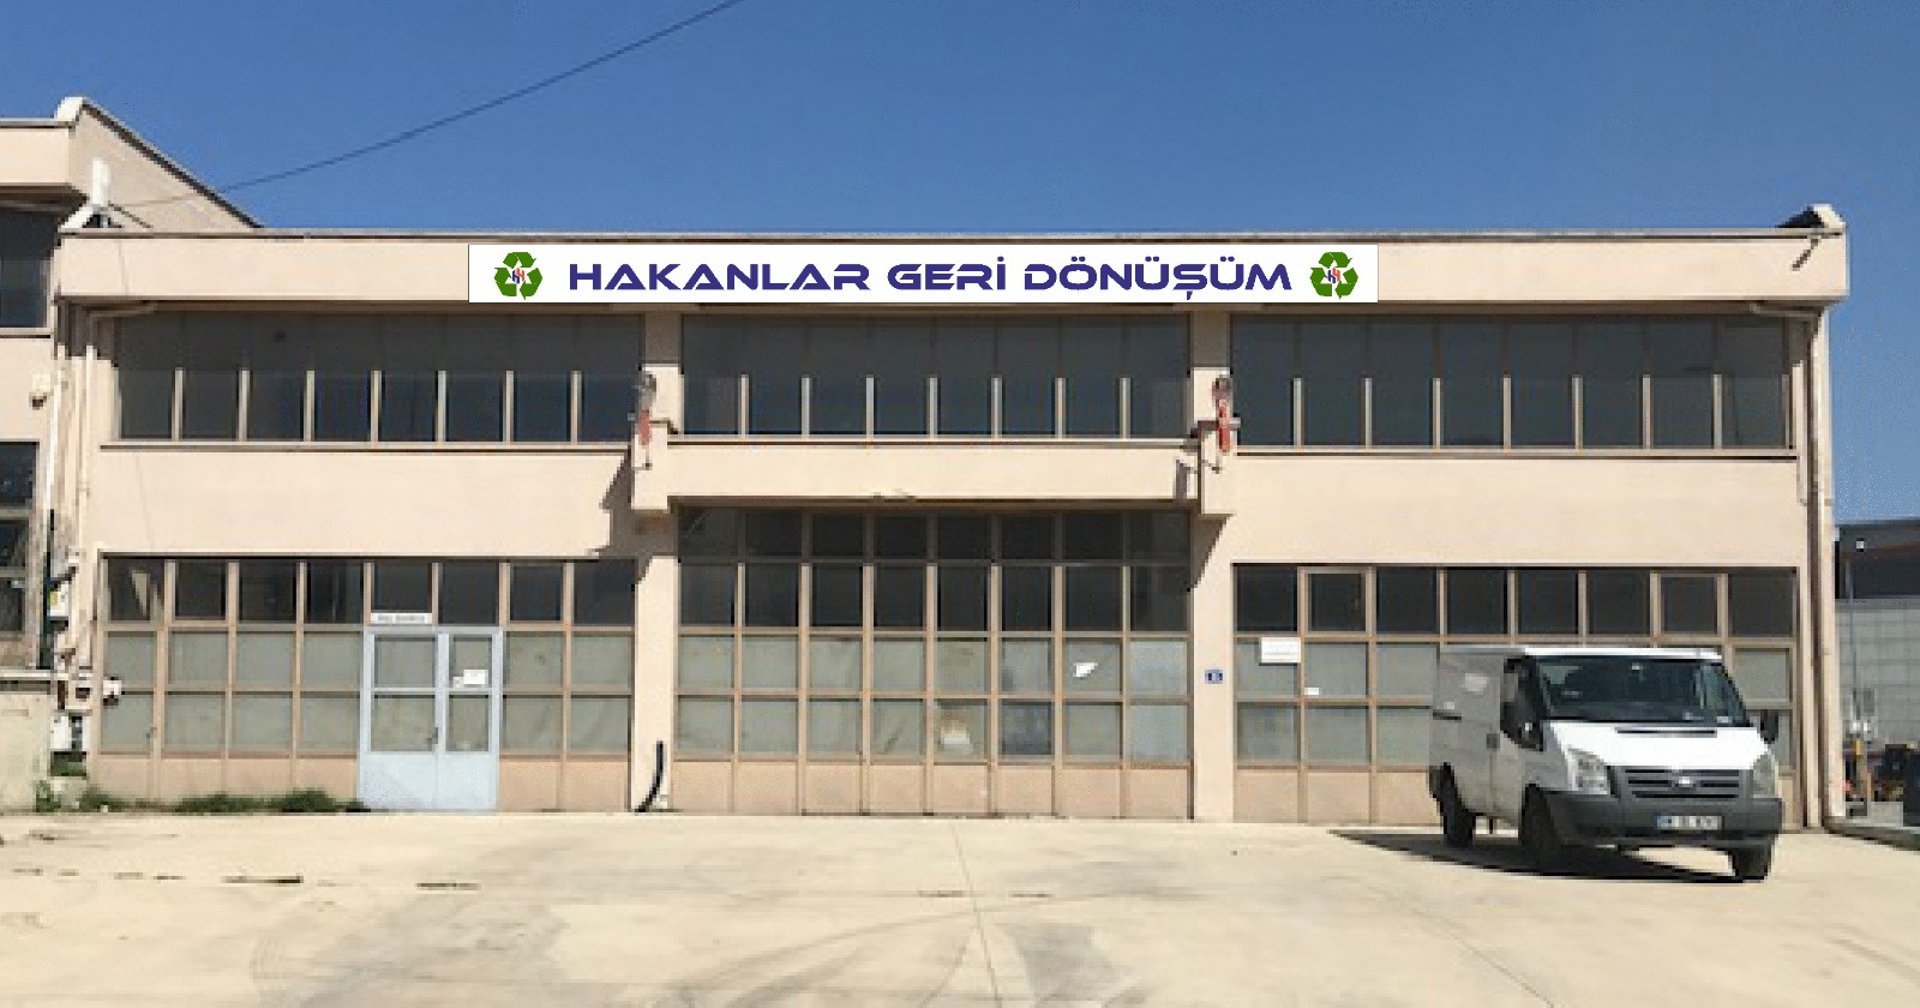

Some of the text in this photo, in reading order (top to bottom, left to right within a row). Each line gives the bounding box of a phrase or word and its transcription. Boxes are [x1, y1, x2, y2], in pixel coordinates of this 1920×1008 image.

[569, 256, 1292, 300] HAKANLAR GERİ DÖNÜŞÜM
